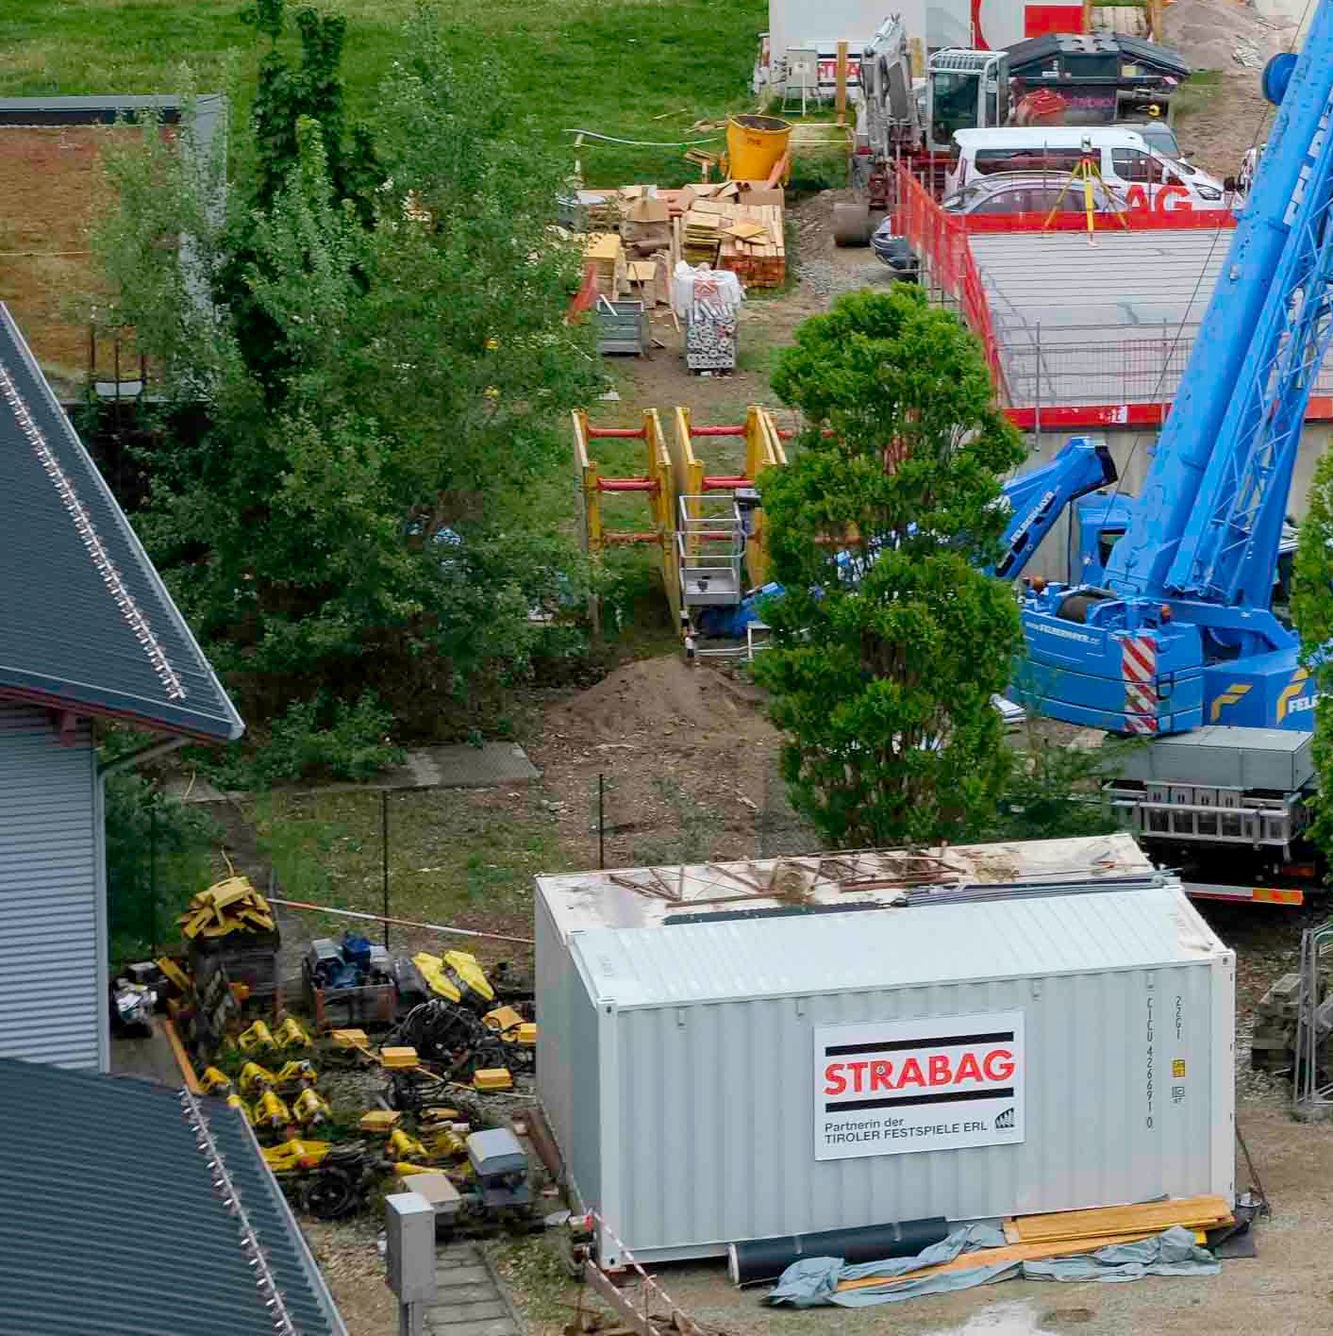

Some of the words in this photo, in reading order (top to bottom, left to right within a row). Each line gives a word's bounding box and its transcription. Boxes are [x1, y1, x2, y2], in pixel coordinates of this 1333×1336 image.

[823, 1049, 1015, 1096] STRABAG
[825, 1120, 880, 1132] Partnerin
[883, 1117, 904, 1128] der
[825, 1130, 882, 1144] TIROLER
[884, 1124, 960, 1139] FESTSPIELE
[964, 1122, 988, 1132] ERL
